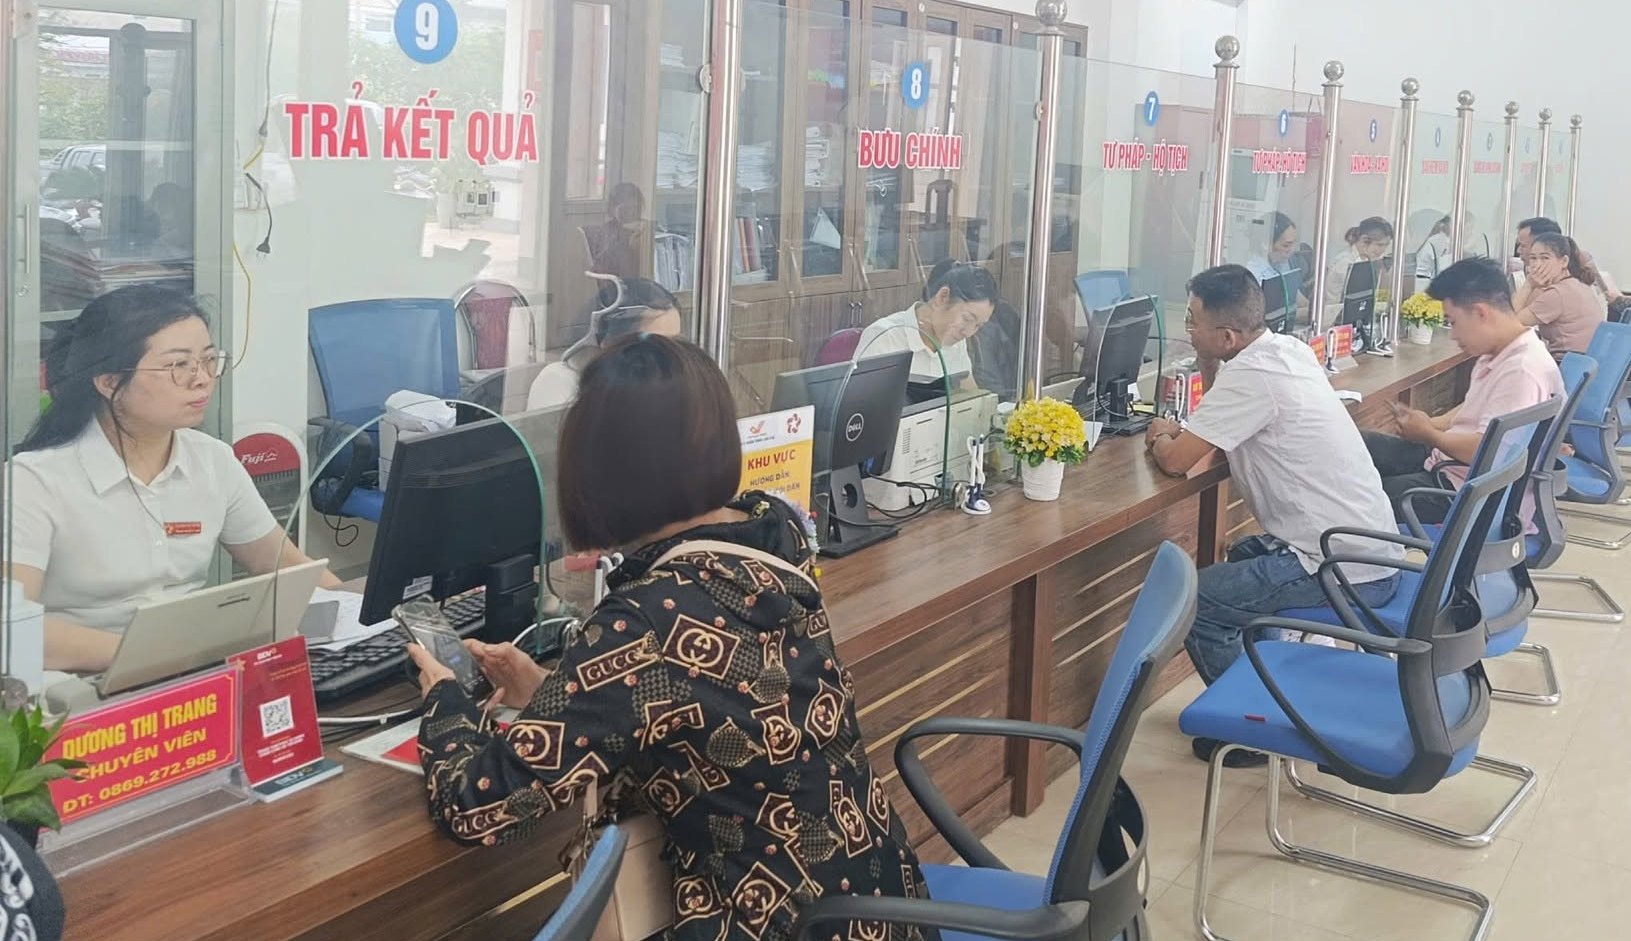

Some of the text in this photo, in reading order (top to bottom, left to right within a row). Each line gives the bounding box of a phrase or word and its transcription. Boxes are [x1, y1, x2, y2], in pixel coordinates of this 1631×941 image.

[415, 2, 439, 51] 9
[910, 67, 922, 100] 8
[284, 81, 539, 166] TRẢ KẾT QUẢ
[1148, 97, 1156, 121] 7
[858, 127, 962, 169] BƯU CHÍNH
[1118, 137, 1146, 171] PHÁP
[1152, 139, 1167, 176] HỘ
[1167, 144, 1189, 176] TỊCH
[240, 451, 266, 465] Fuji
[747, 455, 771, 471] KHU
[586, 646, 641, 680] GUCC
[62, 693, 217, 760] DƯƠNG THỊ TRANG
[163, 728, 207, 754] VIÊN
[451, 808, 500, 834] GUCC
